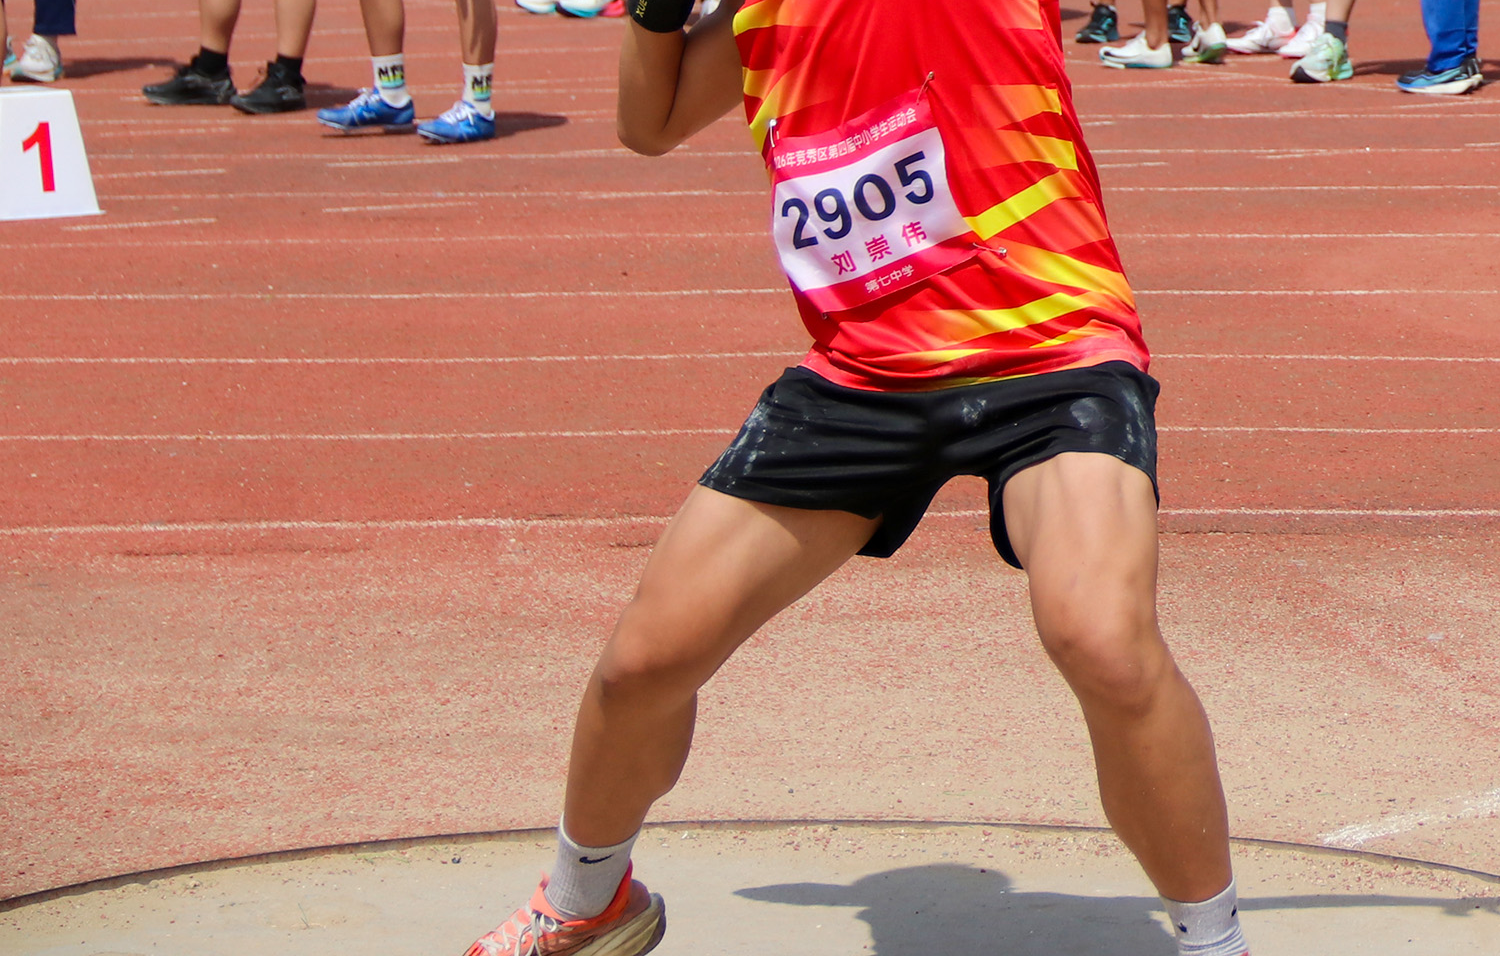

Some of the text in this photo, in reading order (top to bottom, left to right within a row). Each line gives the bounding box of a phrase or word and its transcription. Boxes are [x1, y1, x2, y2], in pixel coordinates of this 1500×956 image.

[22, 121, 55, 193] 1
[781, 150, 935, 250] 2905
[830, 221, 928, 275] 刘崇伟
[864, 263, 915, 294] 第七中学
